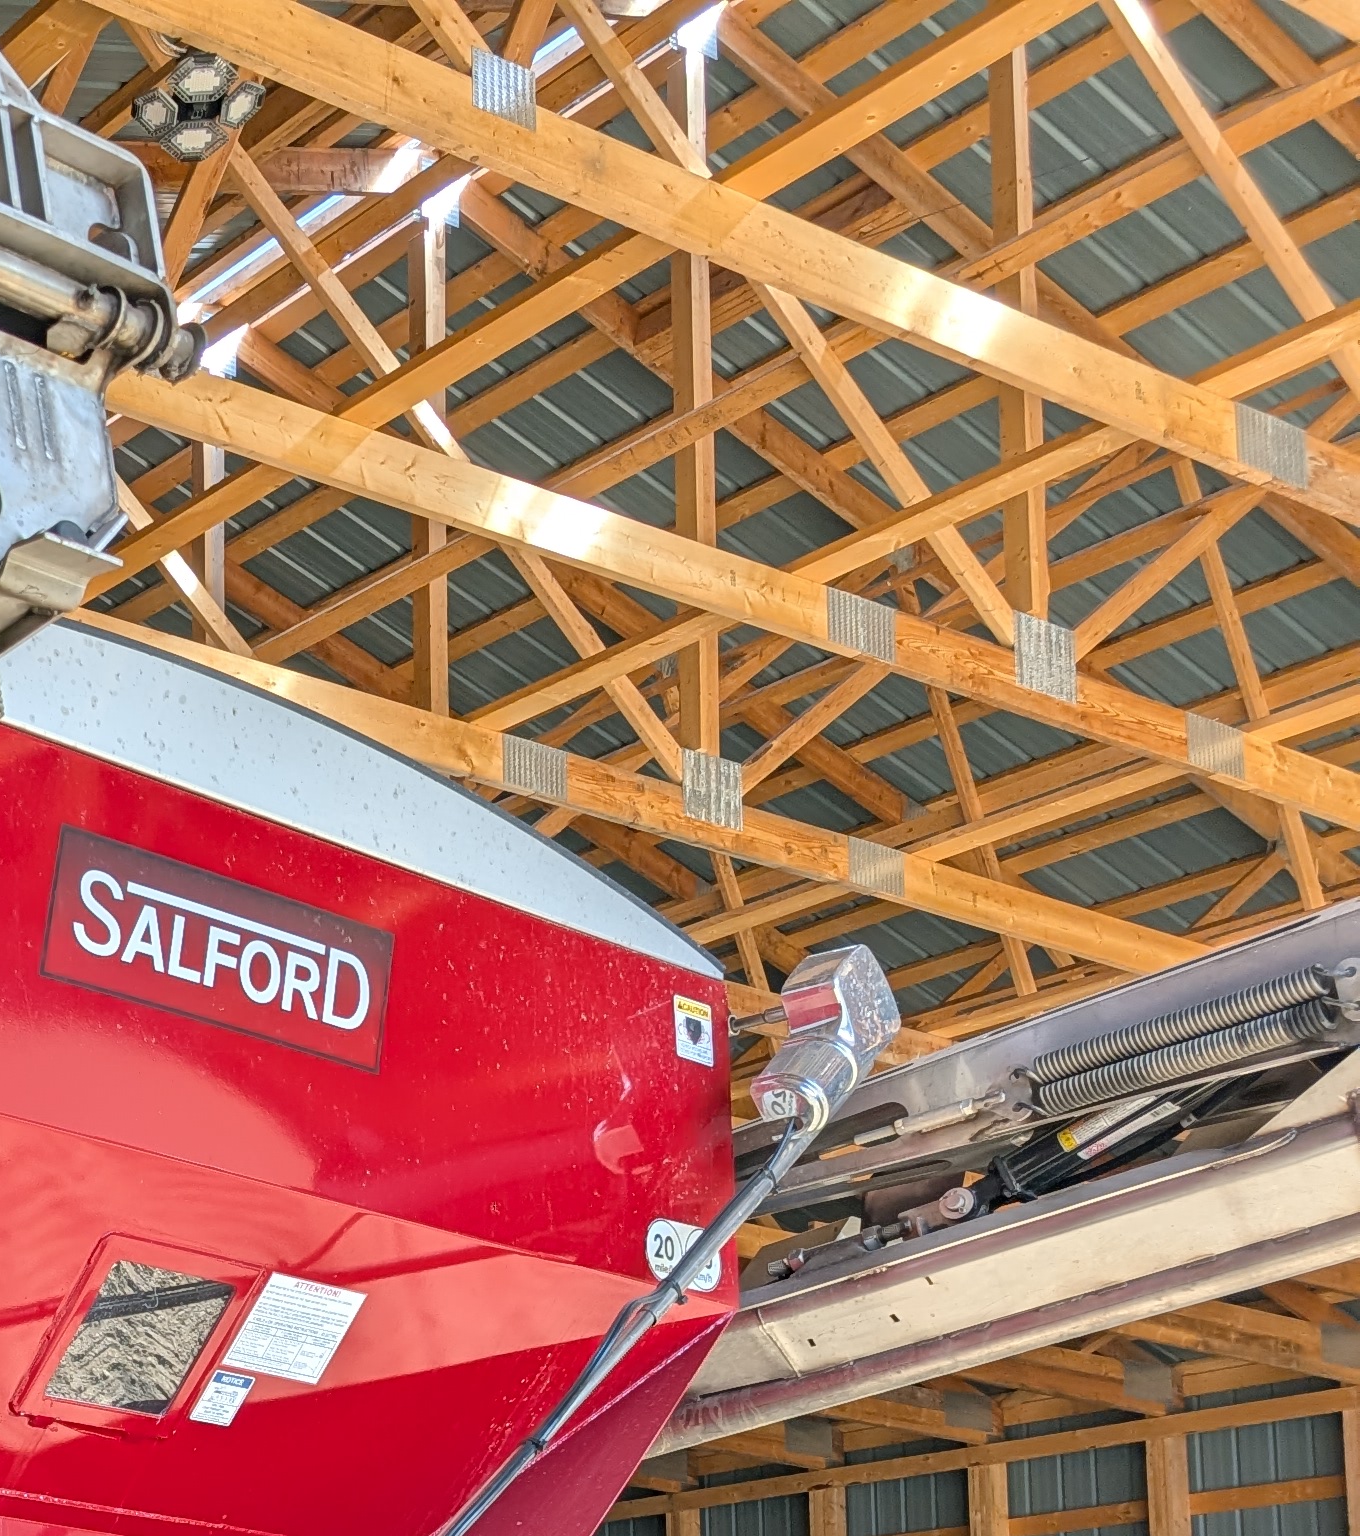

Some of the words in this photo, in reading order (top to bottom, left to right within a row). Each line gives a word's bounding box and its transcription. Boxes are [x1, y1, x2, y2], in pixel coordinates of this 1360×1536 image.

[72, 868, 371, 1031] SALFORD
[653, 1233, 675, 1262] 20
[293, 1281, 342, 1298] ATTENTION!
[220, 1375, 245, 1387] NOTICE
